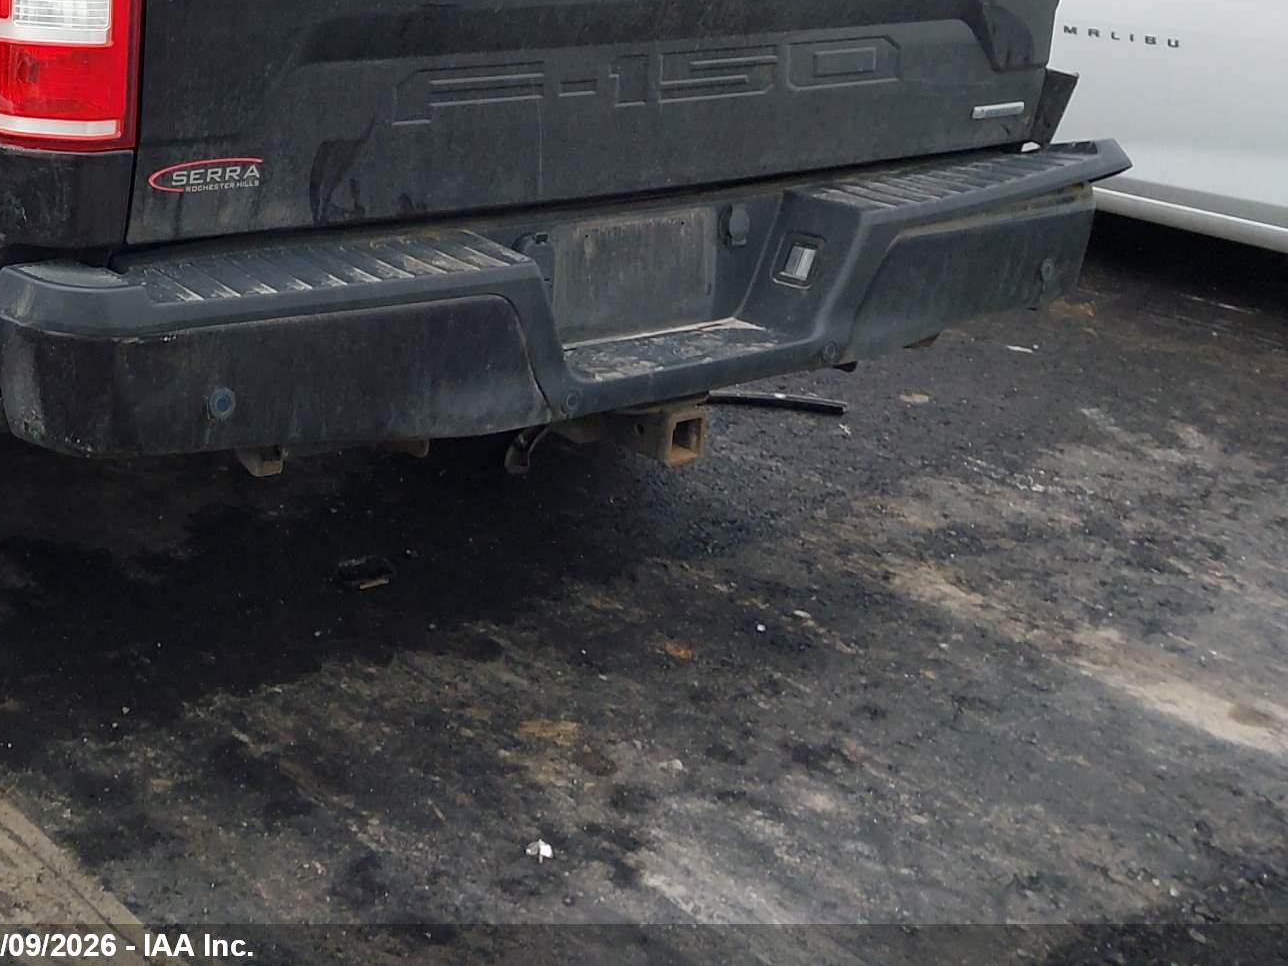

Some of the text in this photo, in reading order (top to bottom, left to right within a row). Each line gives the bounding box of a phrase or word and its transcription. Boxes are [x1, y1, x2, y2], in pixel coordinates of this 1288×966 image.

[1063, 25, 1179, 48] MALIBU
[392, 34, 901, 125] F-150
[172, 164, 260, 186] SERRA
[185, 179, 260, 192] ROCHESTER HILLS
